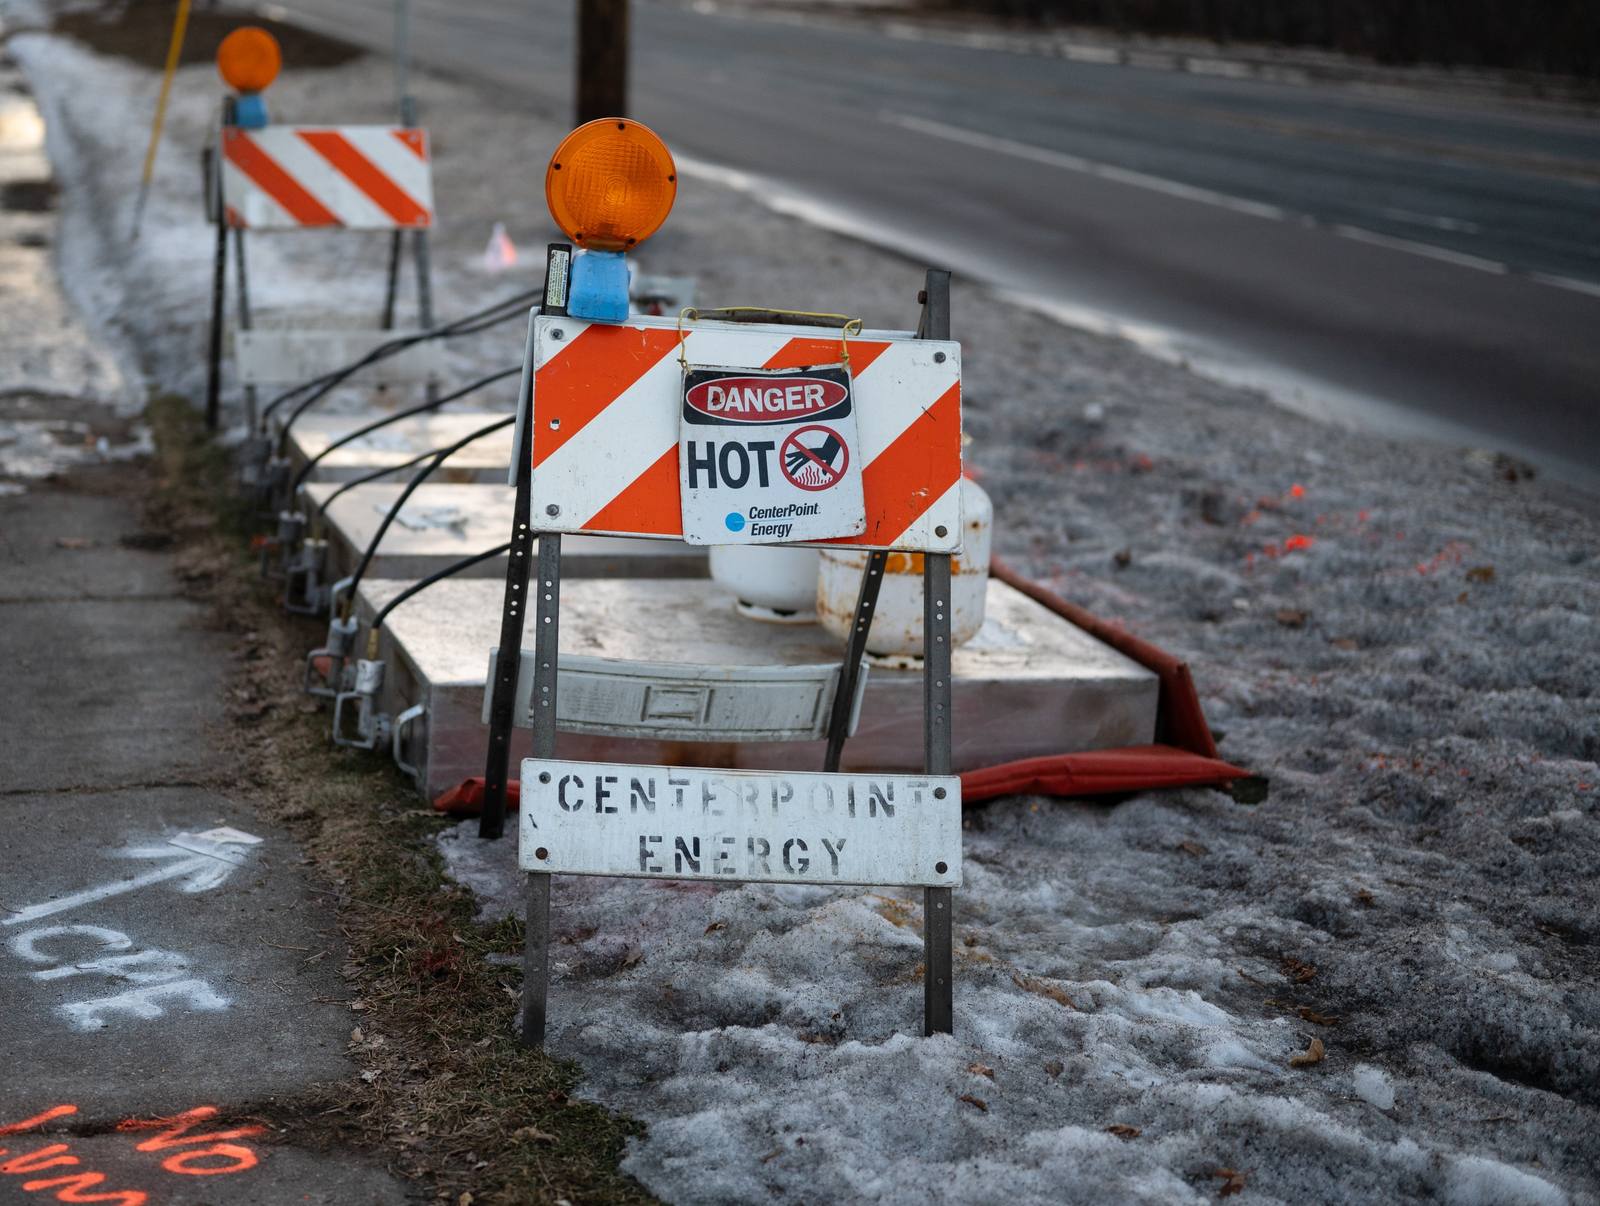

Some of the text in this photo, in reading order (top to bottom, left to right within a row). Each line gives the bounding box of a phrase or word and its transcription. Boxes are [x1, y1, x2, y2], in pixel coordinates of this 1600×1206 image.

[706, 384, 826, 412] DANGER
[687, 441, 775, 490] HOT
[751, 523, 793, 538] Energy
[558, 774, 929, 819] CENTERPOINT
[639, 835, 847, 876] ENERGY
